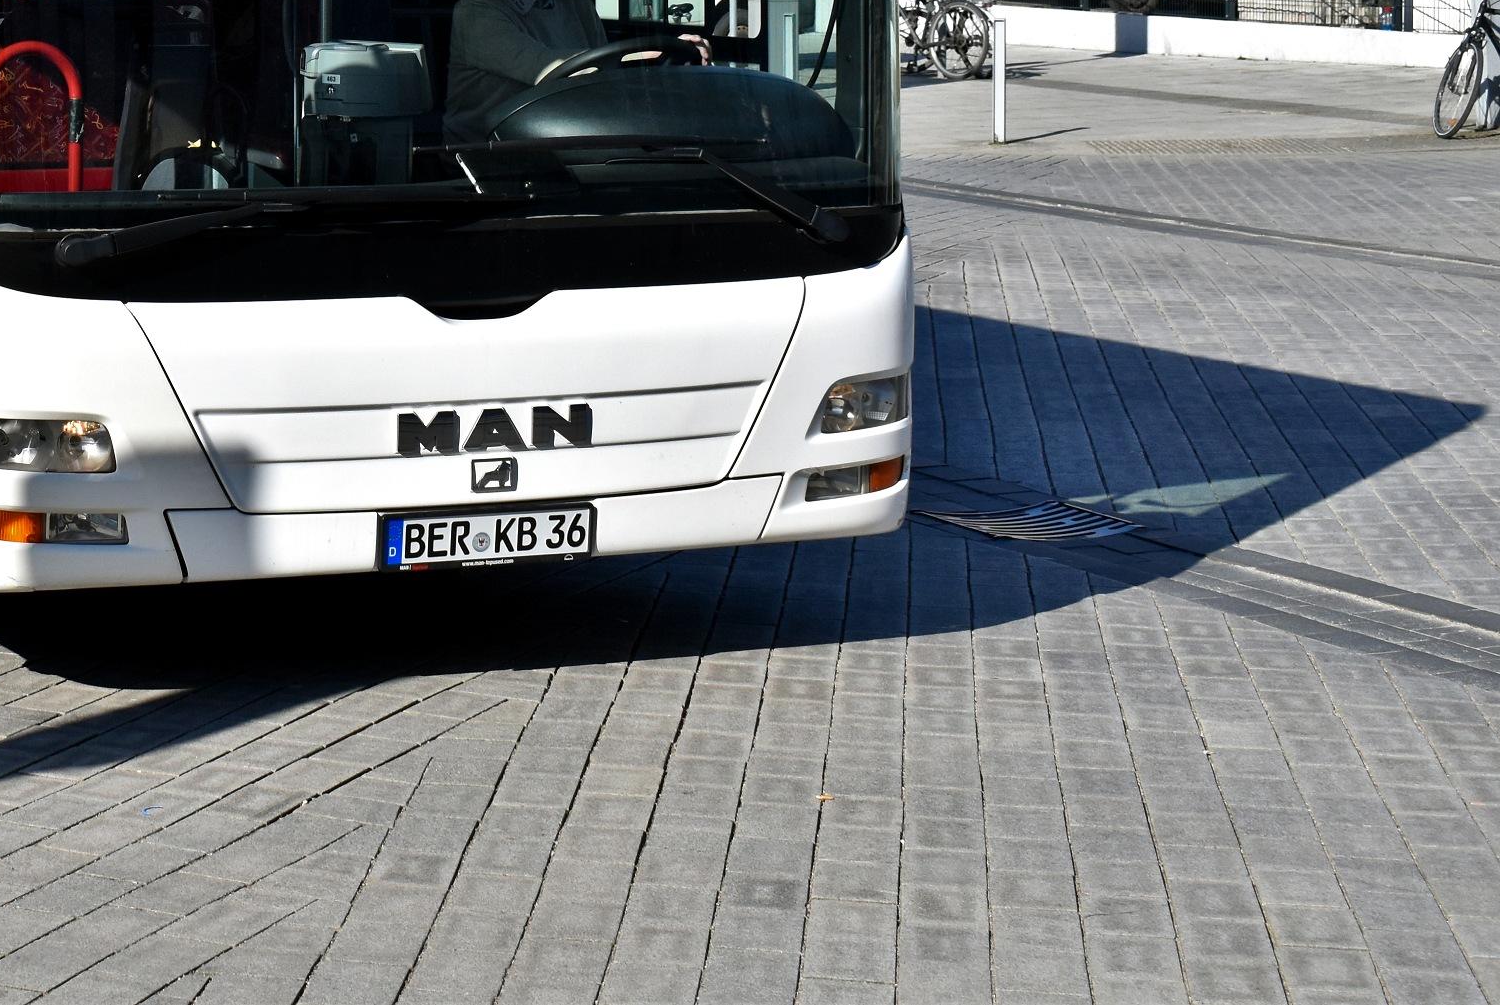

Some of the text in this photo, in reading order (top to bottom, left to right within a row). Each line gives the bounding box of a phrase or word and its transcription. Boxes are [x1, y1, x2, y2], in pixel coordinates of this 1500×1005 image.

[397, 402, 593, 458] MAN
[388, 546, 397, 558] D
[405, 513, 586, 559] BER KB 36
